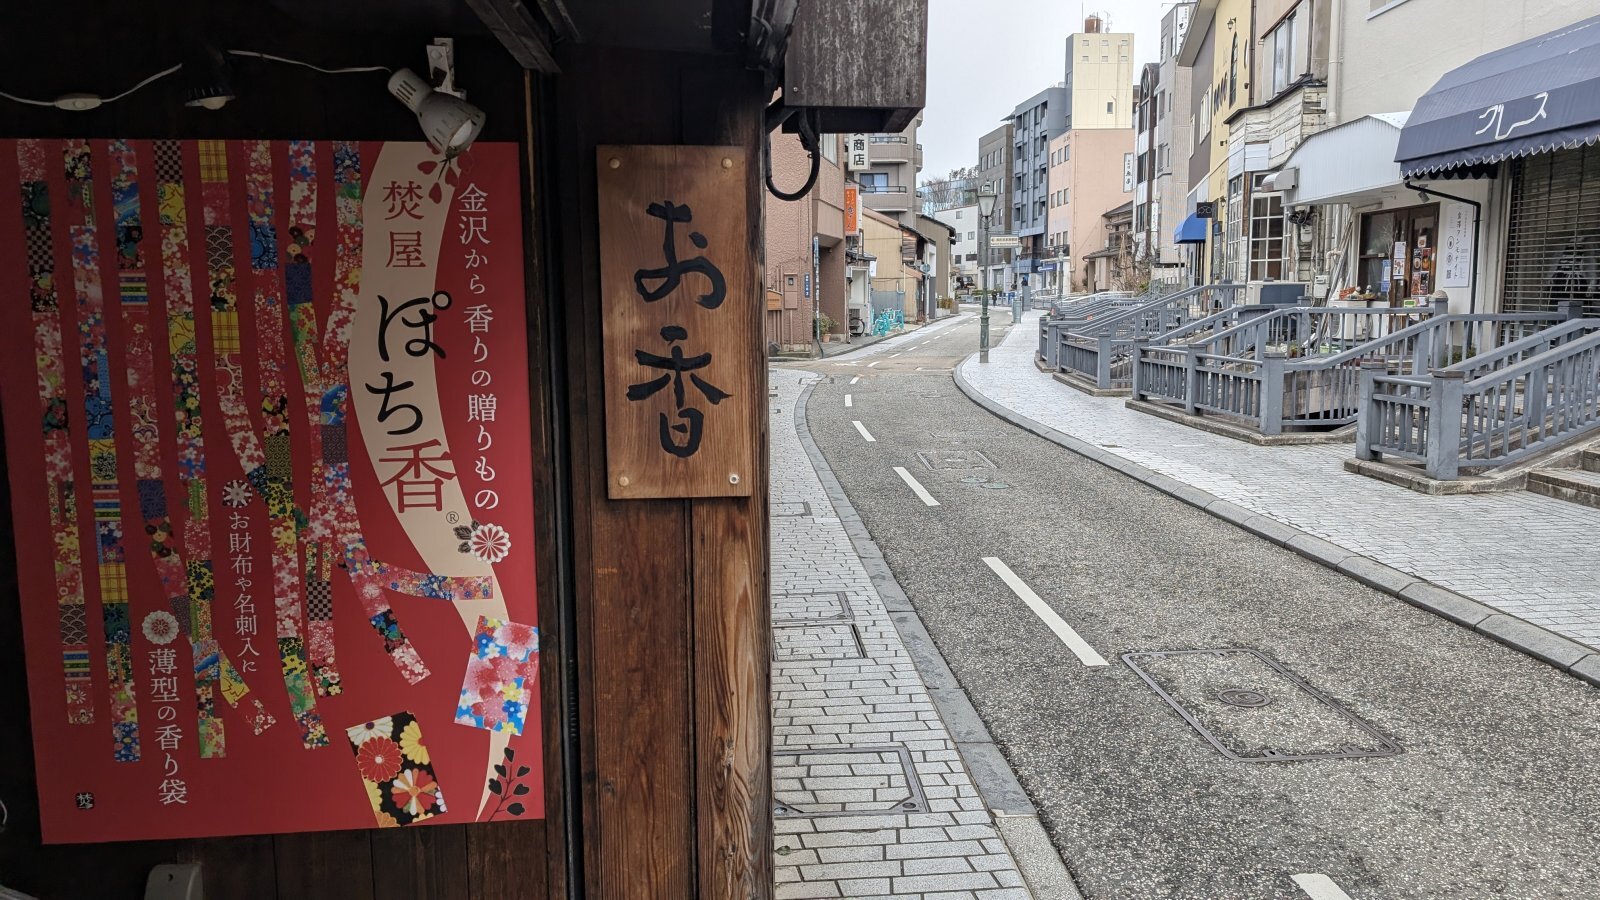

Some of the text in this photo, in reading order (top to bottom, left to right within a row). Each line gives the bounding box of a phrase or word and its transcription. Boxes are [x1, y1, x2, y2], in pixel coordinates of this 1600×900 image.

[382, 179, 427, 269] 焚屋
[853, 133, 865, 167] 商店
[364, 289, 457, 514] ぽち香
[456, 182, 499, 511] 金沢から香りの贈りもの
[625, 200, 733, 458] お香
[228, 511, 260, 673] お財布や名刺入に
[148, 648, 189, 806] 薄型の香り袋
